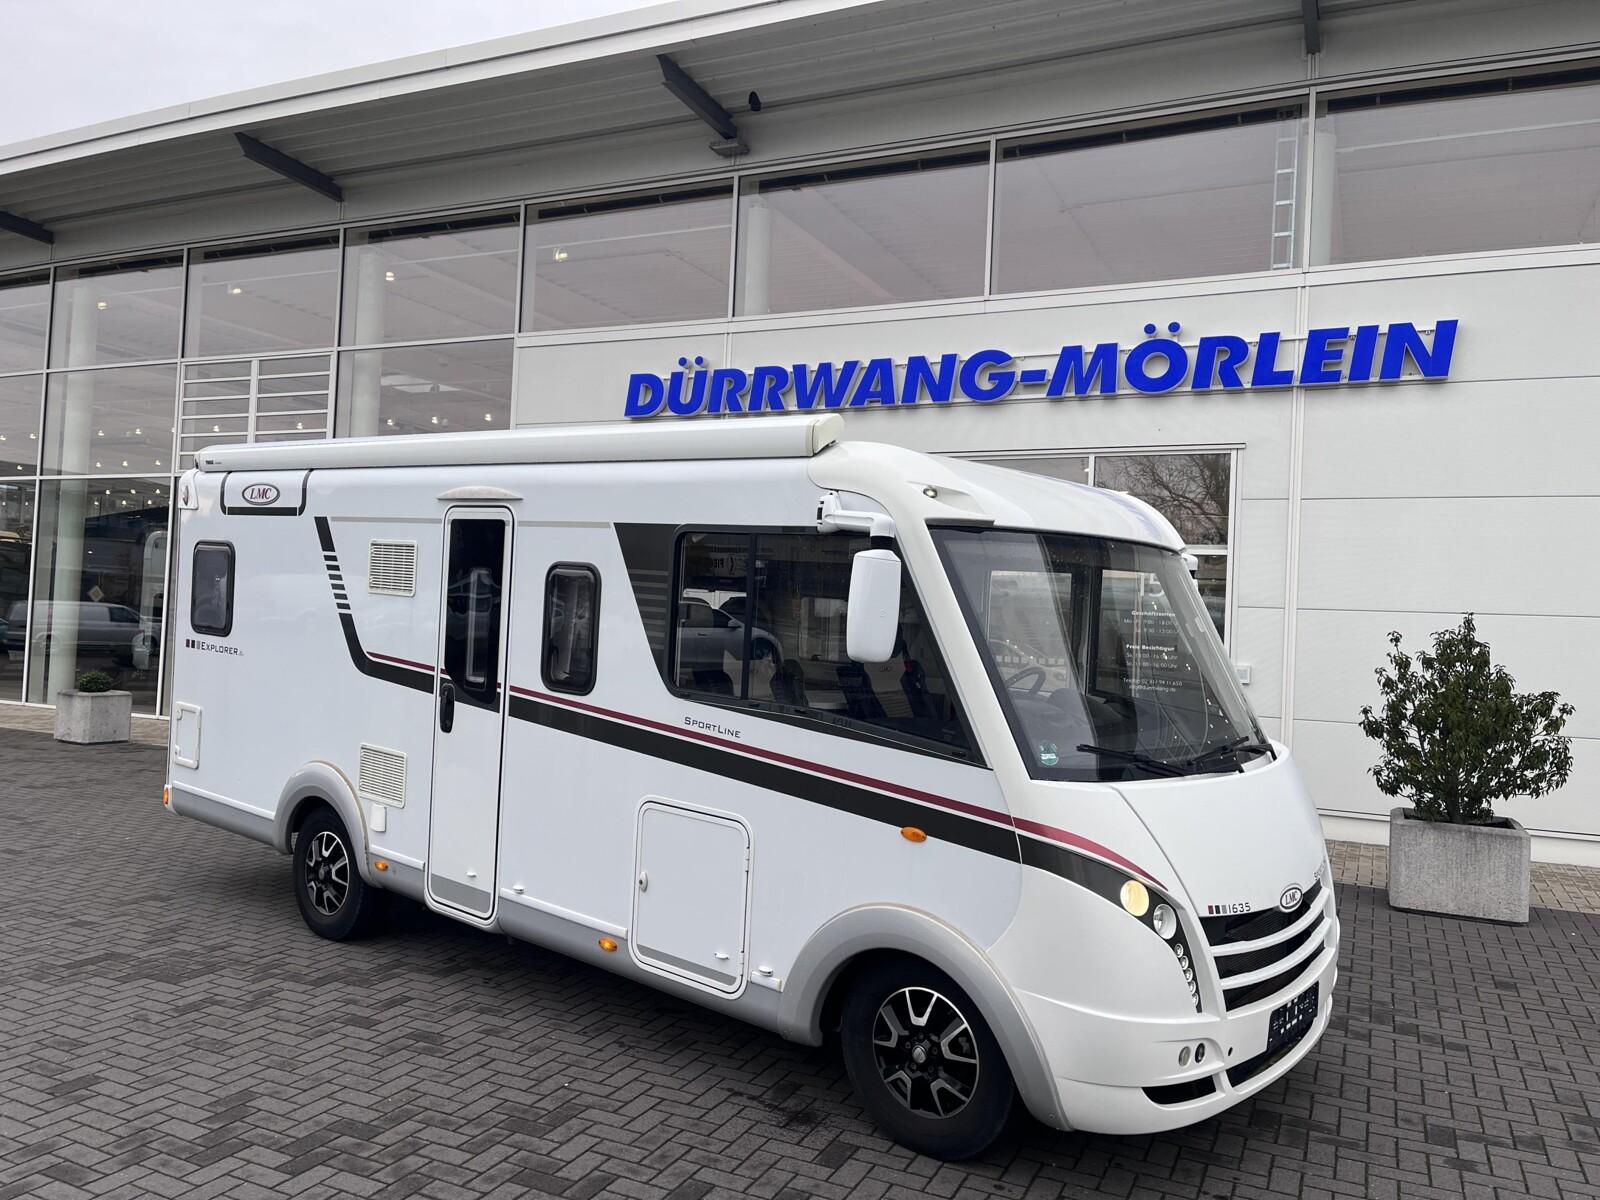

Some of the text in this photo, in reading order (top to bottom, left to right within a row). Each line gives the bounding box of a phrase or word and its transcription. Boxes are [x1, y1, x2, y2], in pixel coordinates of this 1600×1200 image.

[624, 320, 1459, 420] DÜRRWANG-MÖRLEIN
[250, 487, 271, 499] LMC
[201, 641, 239, 656] EXPLORER
[684, 716, 742, 739] SPORTLINE
